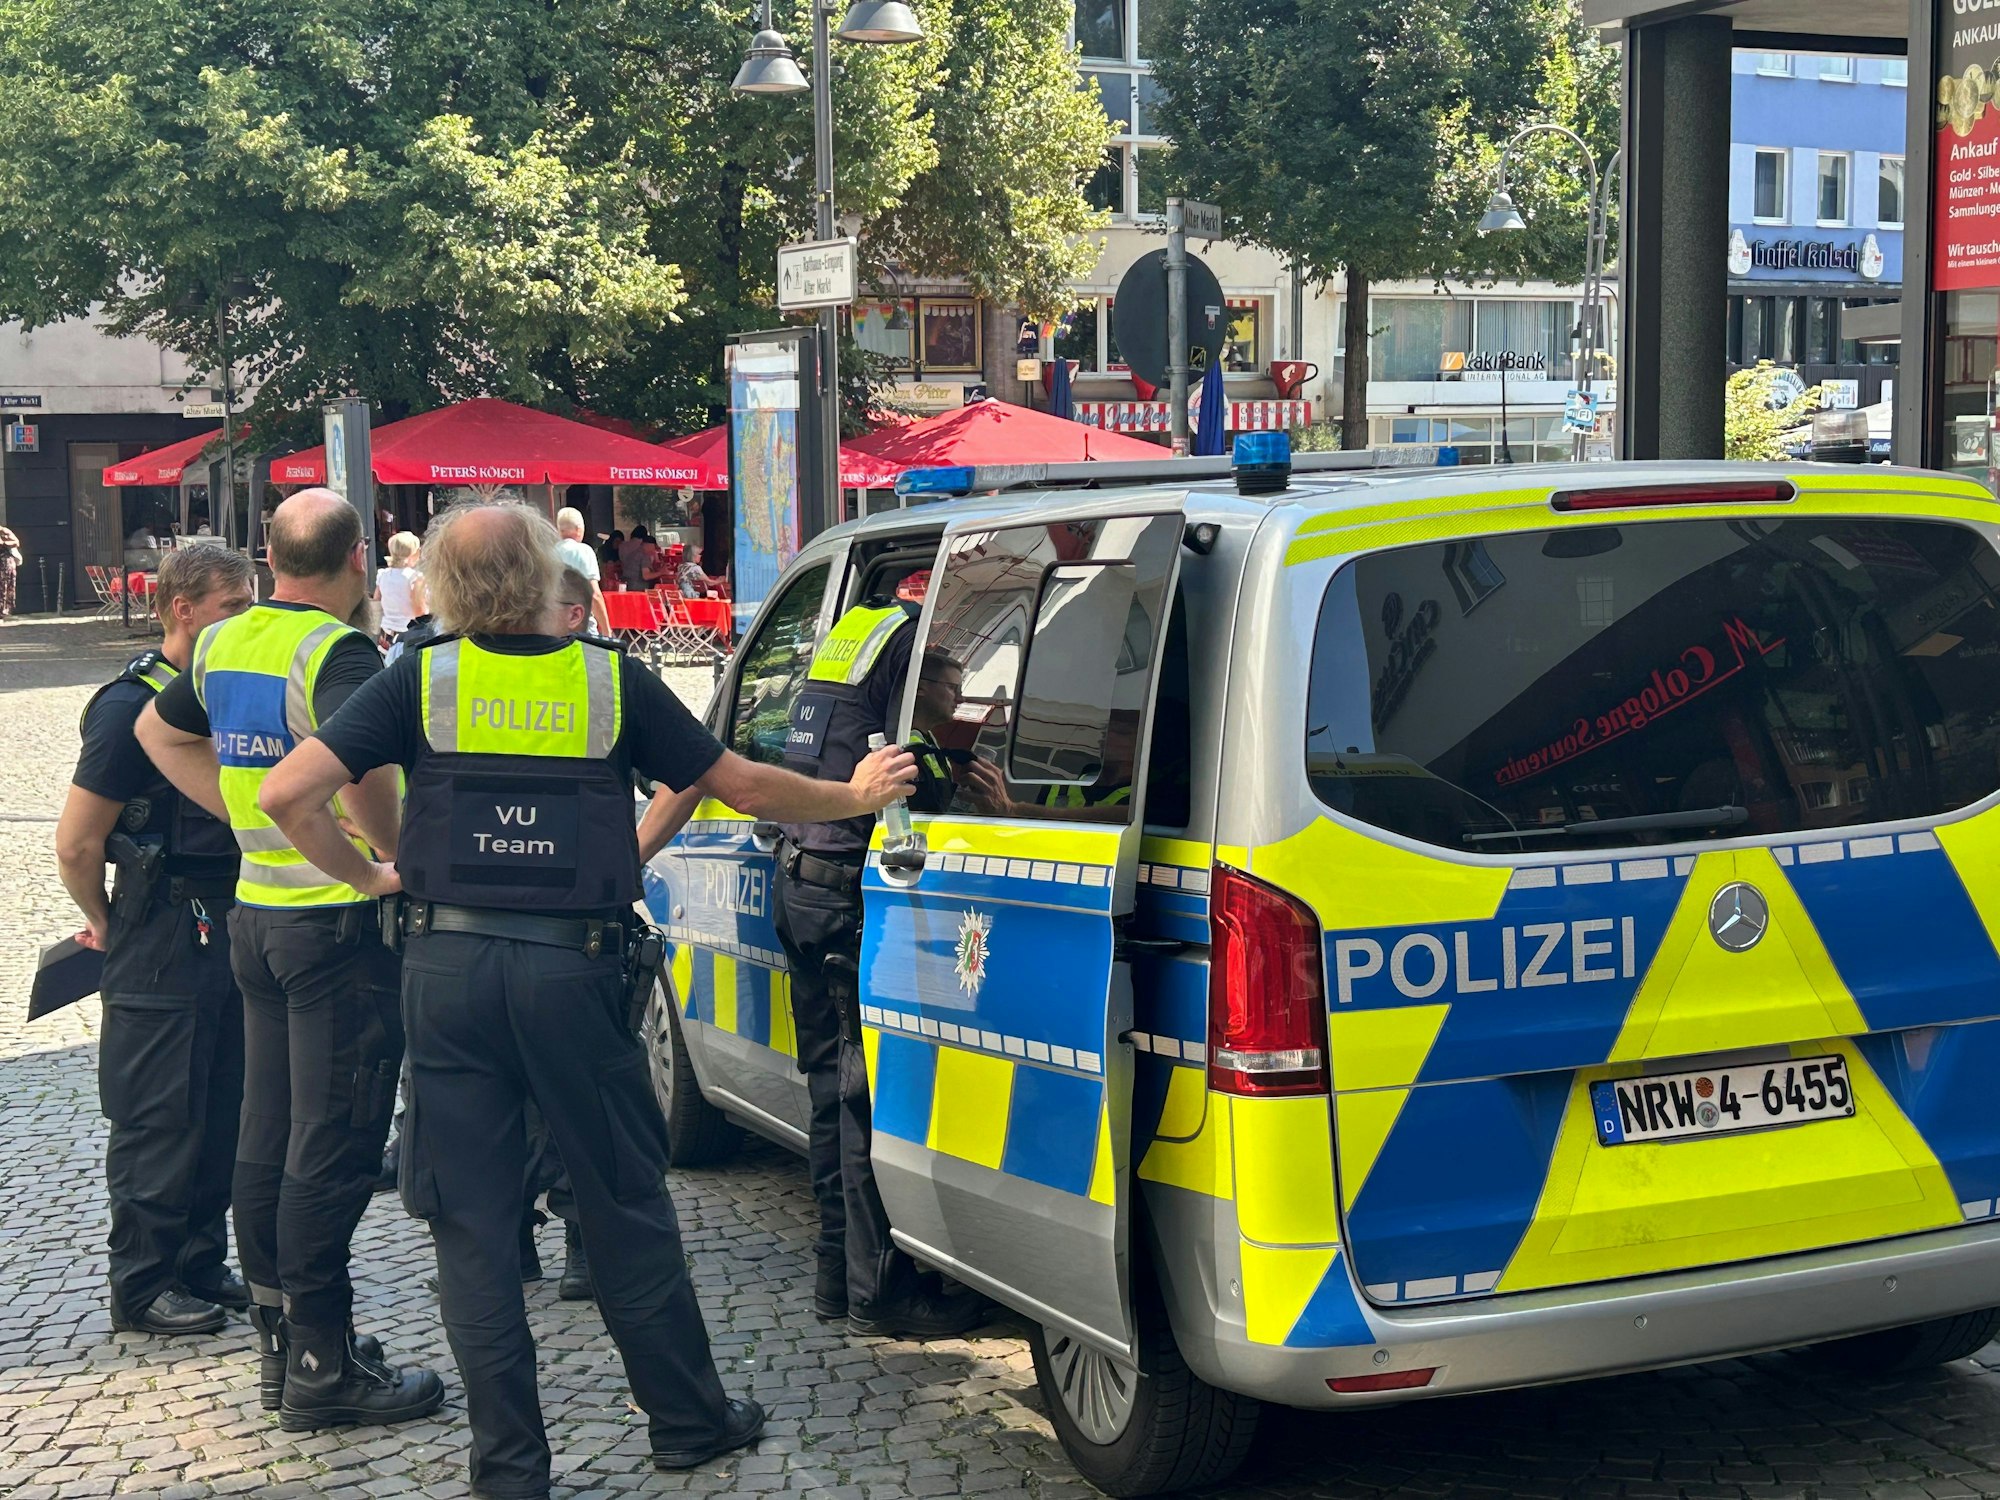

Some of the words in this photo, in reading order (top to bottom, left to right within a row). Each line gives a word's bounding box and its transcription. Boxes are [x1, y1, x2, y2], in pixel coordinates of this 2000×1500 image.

[1950, 137, 1999, 161] Ankauf
[1949, 168, 1971, 183] Gold
[1977, 165, 2000, 180] Silbe
[1949, 186, 1984, 200] Münzen
[1184, 206, 1200, 229] Alter
[1200, 210, 1219, 232] Markt
[1949, 202, 2000, 219] Sammlunge
[1947, 243, 1965, 257] Wir
[1966, 240, 2000, 256] tausch
[817, 277, 832, 295] Markt
[1467, 372, 1531, 381] INTERNAIONAL
[1535, 372, 1545, 381] AG
[431, 465, 477, 478] PETERS
[610, 466, 653, 479] PETERS
[471, 697, 576, 733] POLIZEI
[801, 705, 815, 721] VU
[213, 731, 286, 758] U-TEAM
[786, 727, 814, 745] Team
[495, 805, 537, 826] VU
[472, 833, 555, 855] Team
[704, 862, 766, 918] POLIZEI
[1335, 916, 1636, 1004] POLIZEI
[1616, 1079, 1697, 1135] NRW
[1719, 1061, 1849, 1121] 4-6455
[1603, 1120, 1615, 1134] D
